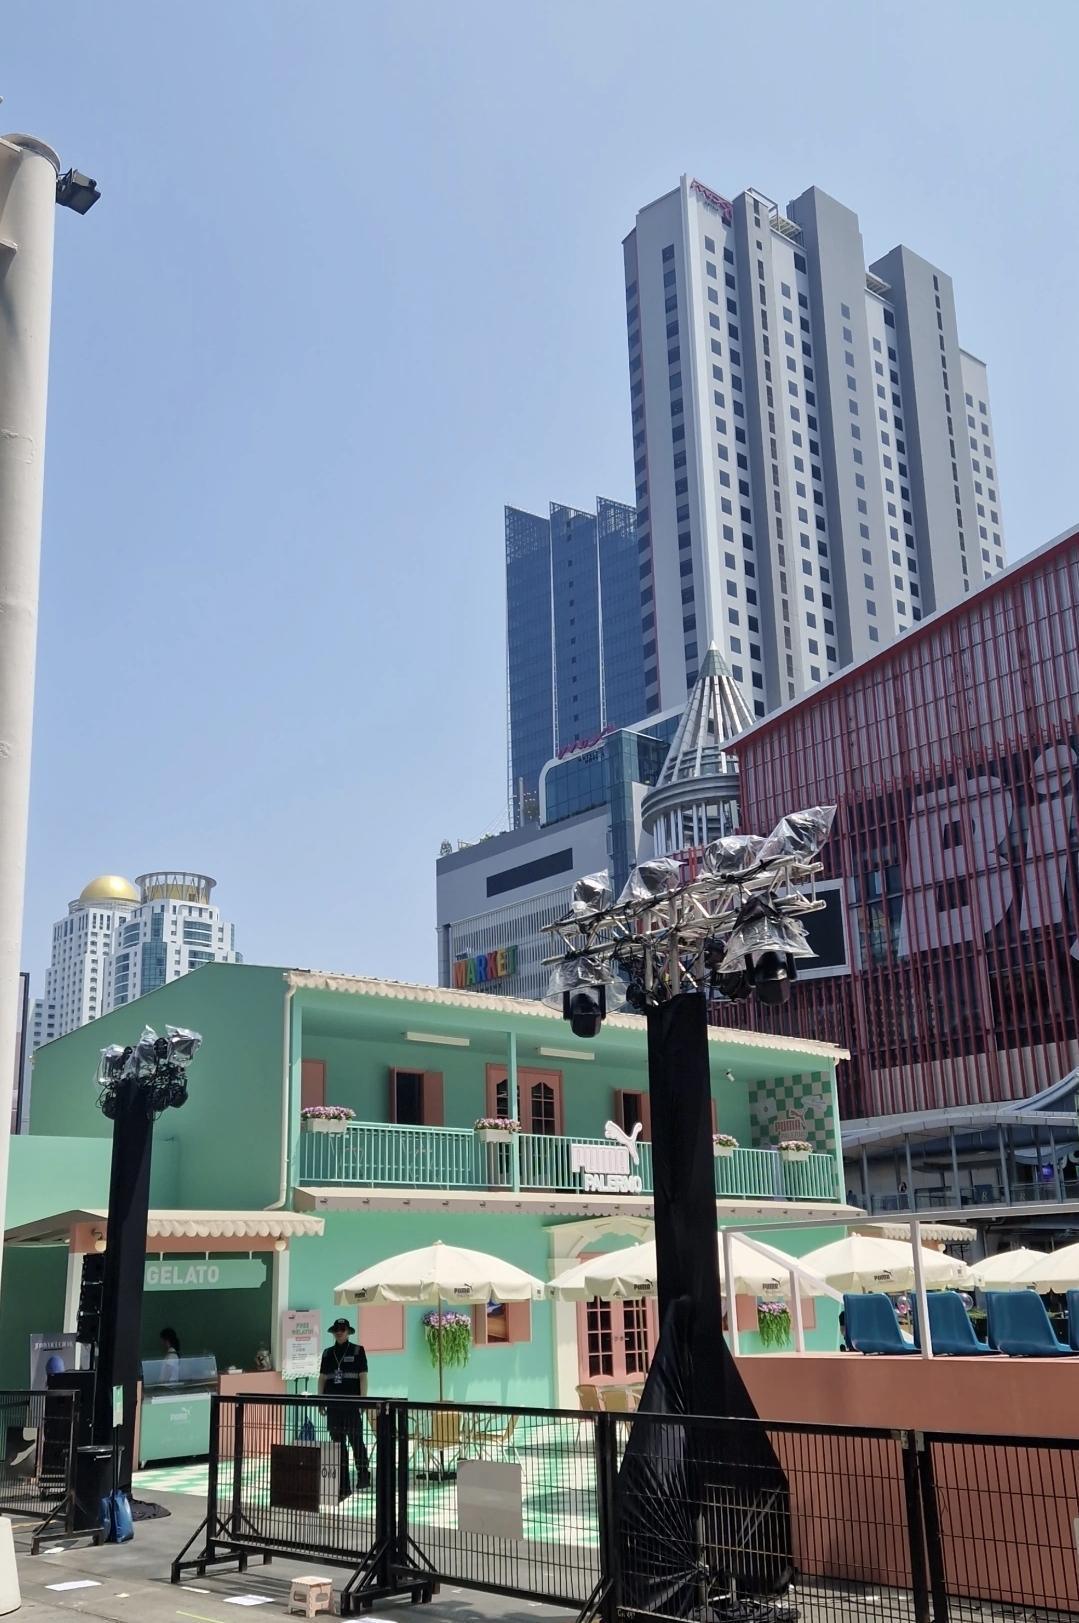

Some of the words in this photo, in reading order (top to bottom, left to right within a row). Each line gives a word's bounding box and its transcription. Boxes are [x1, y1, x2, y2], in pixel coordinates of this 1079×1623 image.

[453, 944, 518, 989] MARKET
[775, 1120, 801, 1132] PUMA
[571, 1144, 630, 1175] PUMA
[584, 1173, 643, 1193] PALERMO
[146, 1265, 220, 1285] GELATO
